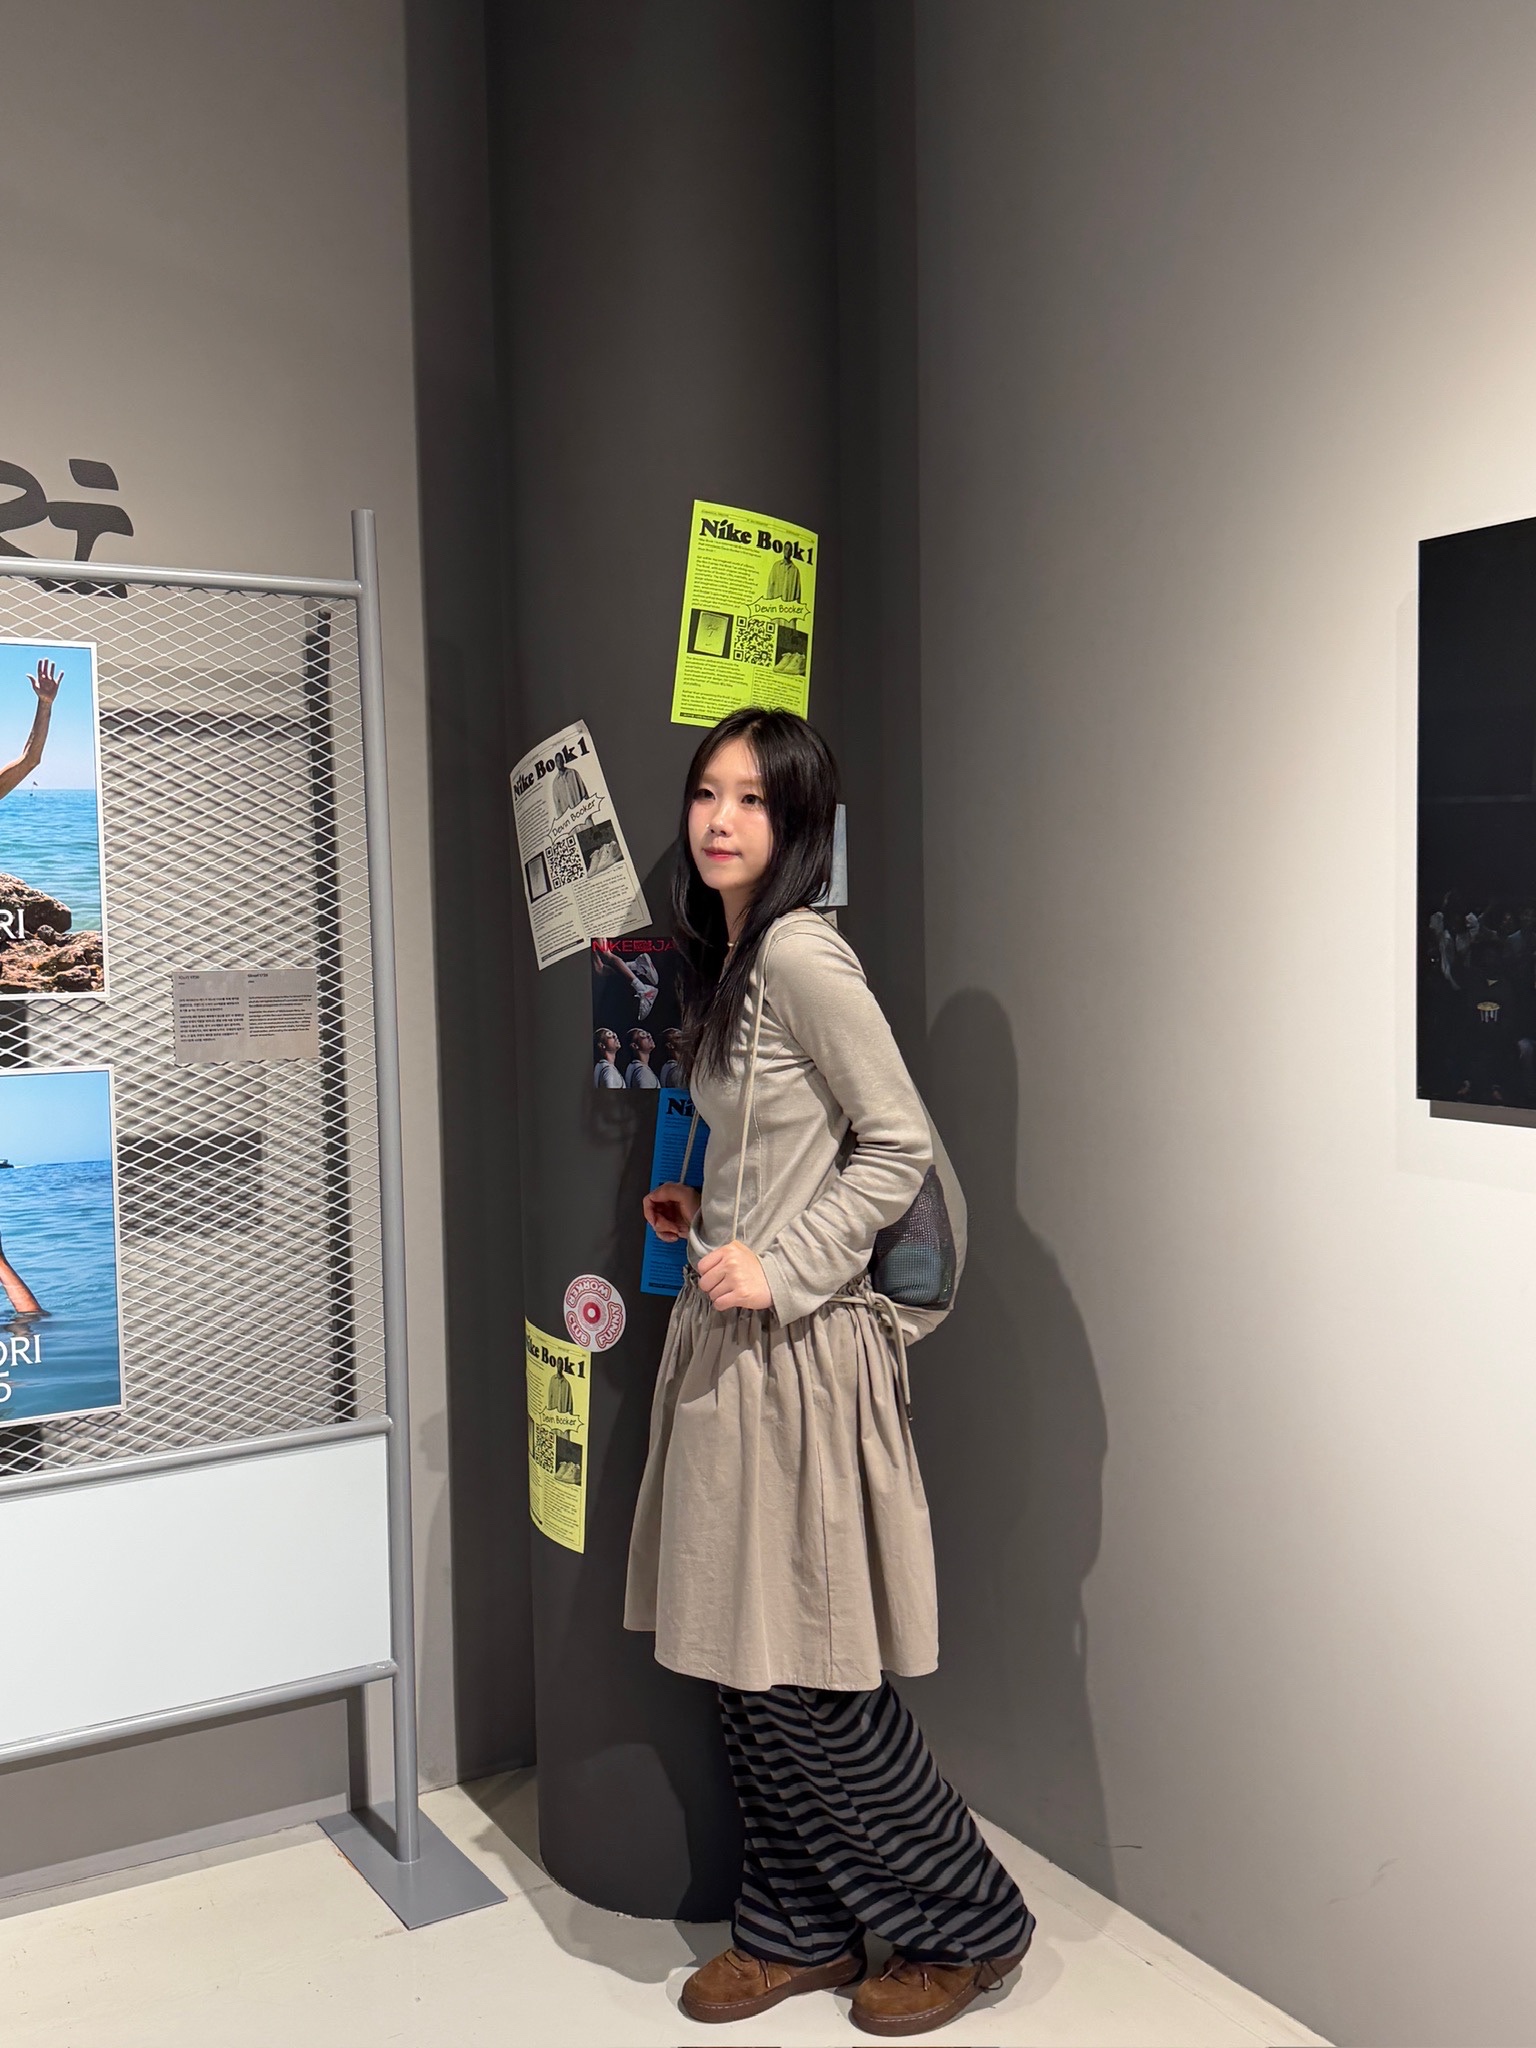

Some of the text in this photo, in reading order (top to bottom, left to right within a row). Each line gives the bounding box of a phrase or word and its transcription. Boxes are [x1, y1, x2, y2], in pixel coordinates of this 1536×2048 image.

[699, 517, 752, 545] Nike
[756, 529, 805, 562] Book
[806, 548, 813, 566] 1
[754, 604, 804, 614] Devin Booker
[513, 771, 535, 801] Nike
[534, 744, 578, 781] Book
[577, 736, 590, 757] 1
[551, 799, 596, 837] Devin Booker
[591, 940, 632, 953] NIKE
[665, 1097, 696, 1118] Ni
[567, 1279, 611, 1306] WORKER
[567, 1312, 589, 1345] CLUB
[598, 1303, 622, 1346] FUNNY
[541, 1346, 575, 1376] Book
[577, 1361, 586, 1379] 1
